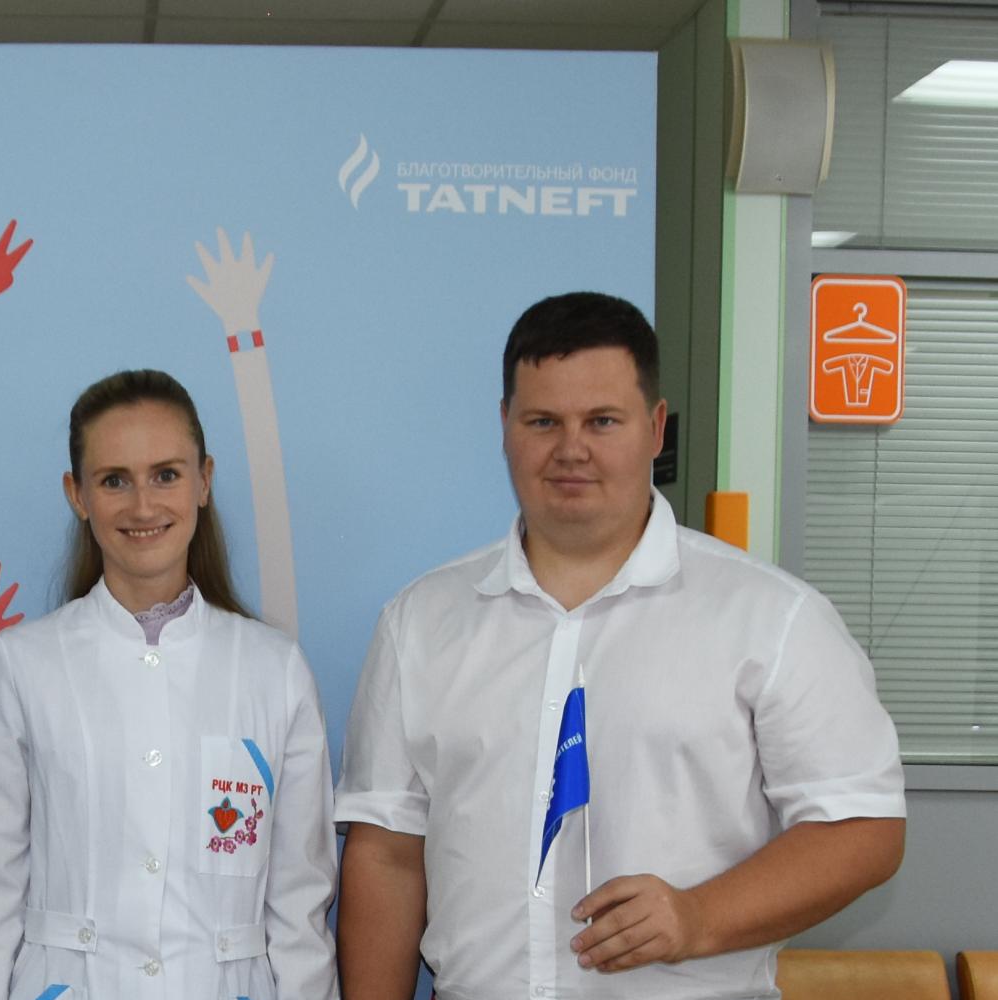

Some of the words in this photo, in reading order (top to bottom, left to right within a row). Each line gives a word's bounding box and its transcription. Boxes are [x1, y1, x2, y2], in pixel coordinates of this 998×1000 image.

[397, 162, 581, 181] БЛАГОТВОРИТЕЛЬНЫЙ
[588, 166, 637, 183] ФОНД
[397, 183, 637, 217] TATNEFT
[212, 779, 233, 794] РЦК
[236, 782, 248, 794] МЗ
[251, 785, 263, 796] РТ
